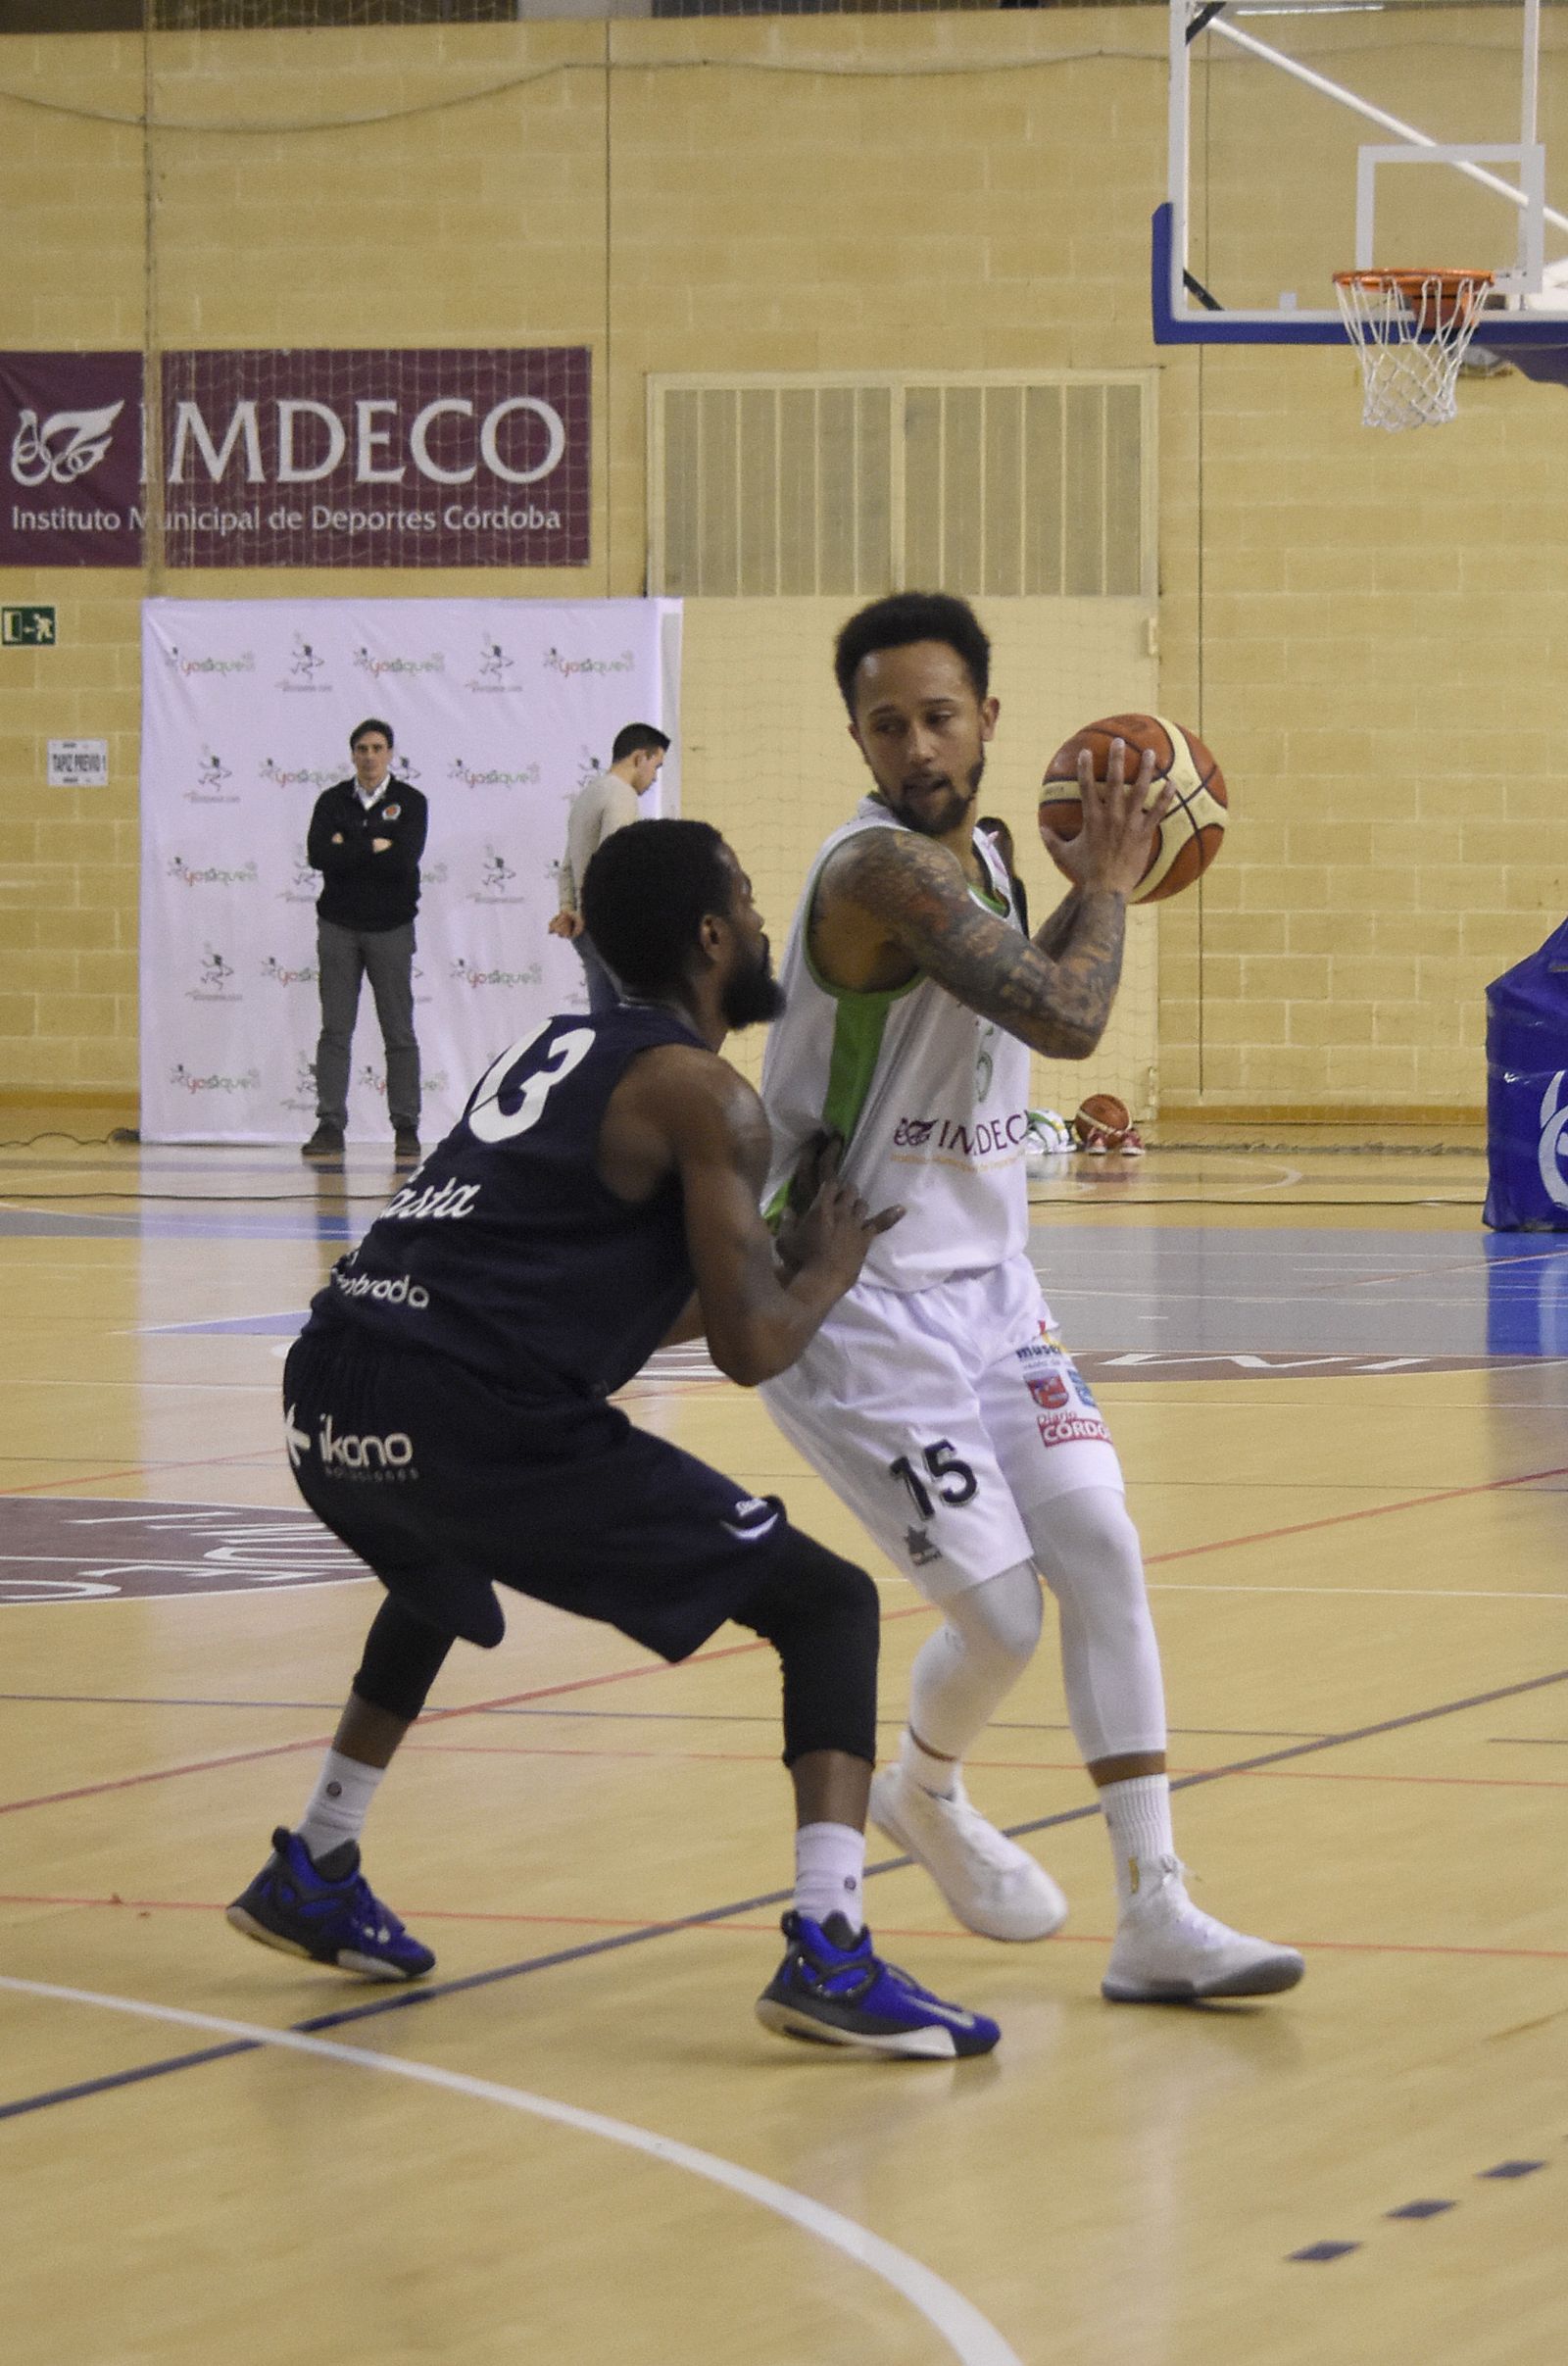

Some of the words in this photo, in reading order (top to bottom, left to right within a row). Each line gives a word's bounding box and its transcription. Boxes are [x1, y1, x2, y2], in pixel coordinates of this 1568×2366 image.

[12, 506, 121, 531] Instituto
[270, 507, 302, 530] de
[313, 507, 436, 535] Deportes
[444, 505, 562, 531] Córdoba
[380, 1177, 481, 1218] asta
[1043, 1417, 1111, 1443] CÓRDO
[889, 1438, 978, 1518] 15
